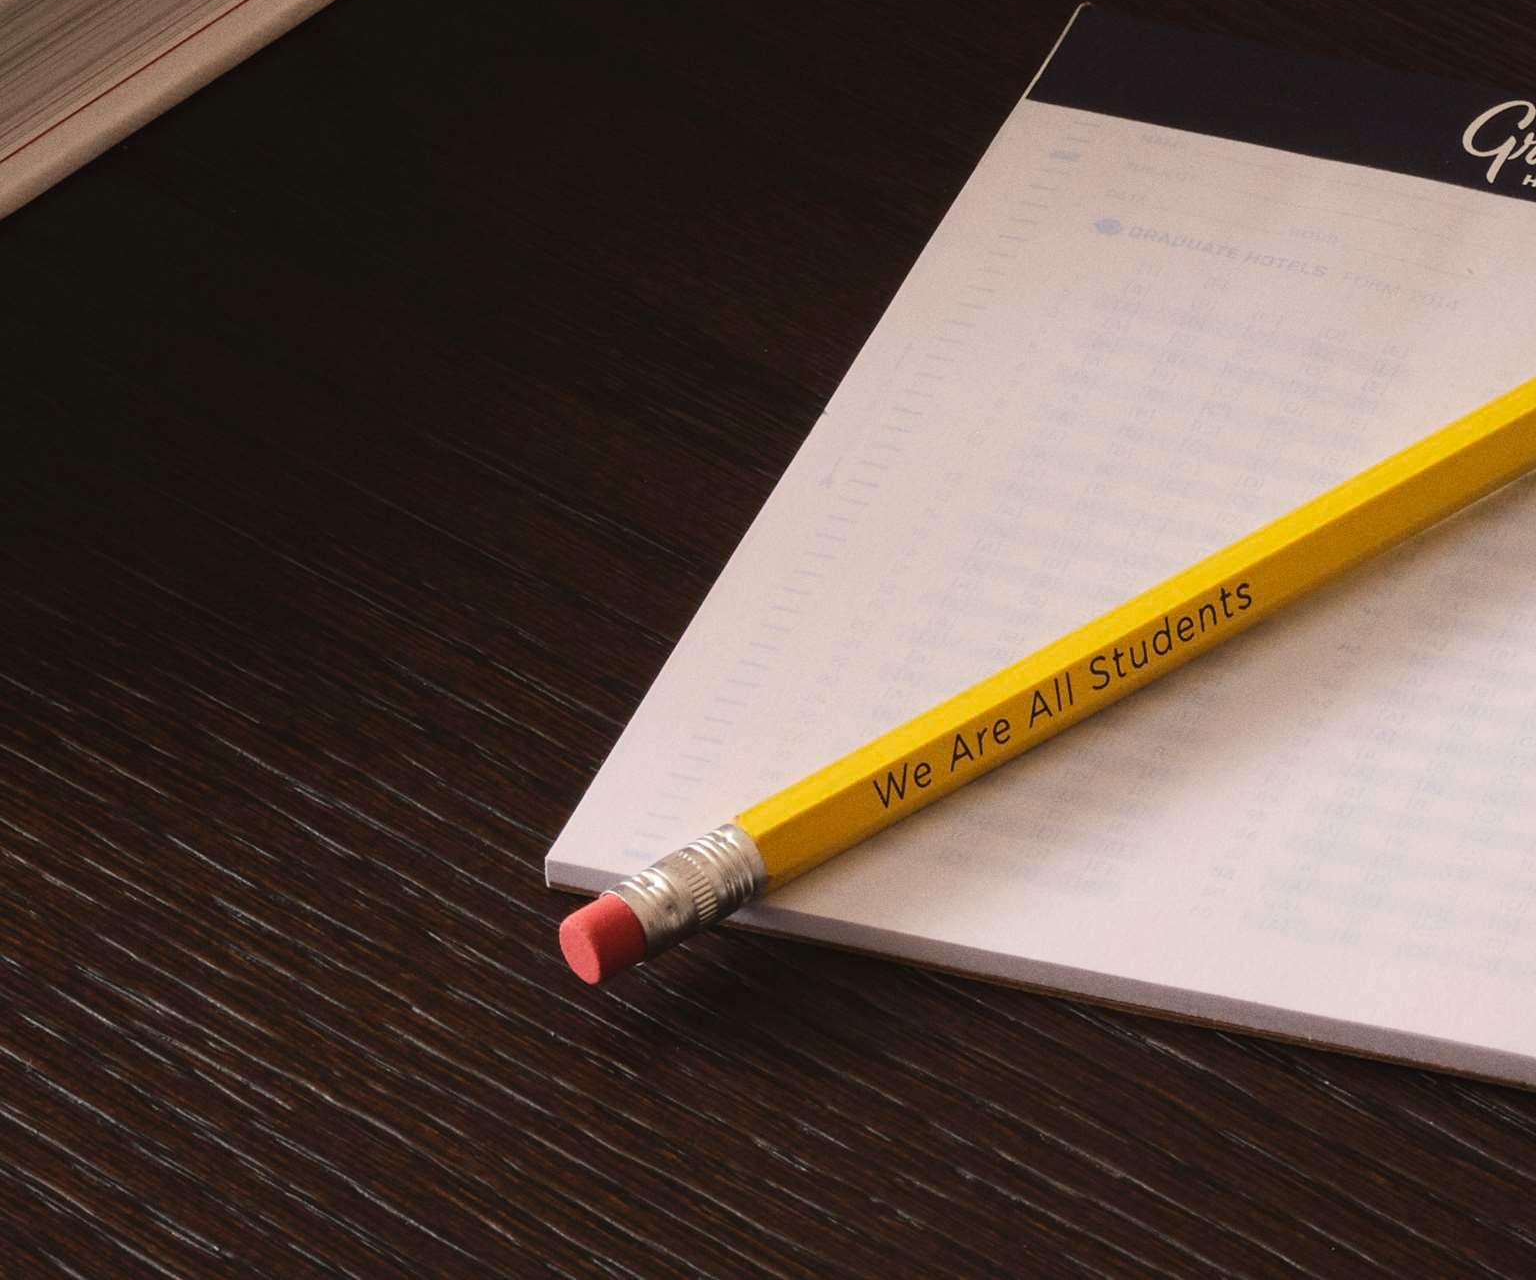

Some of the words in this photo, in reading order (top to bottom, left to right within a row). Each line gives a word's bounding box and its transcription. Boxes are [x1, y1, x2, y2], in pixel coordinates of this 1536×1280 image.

[1127, 225, 1241, 259] GRADUATE
[872, 761, 933, 810] We
[949, 717, 1012, 773] Are
[1028, 670, 1075, 729] All
[1088, 581, 1254, 691] Students
